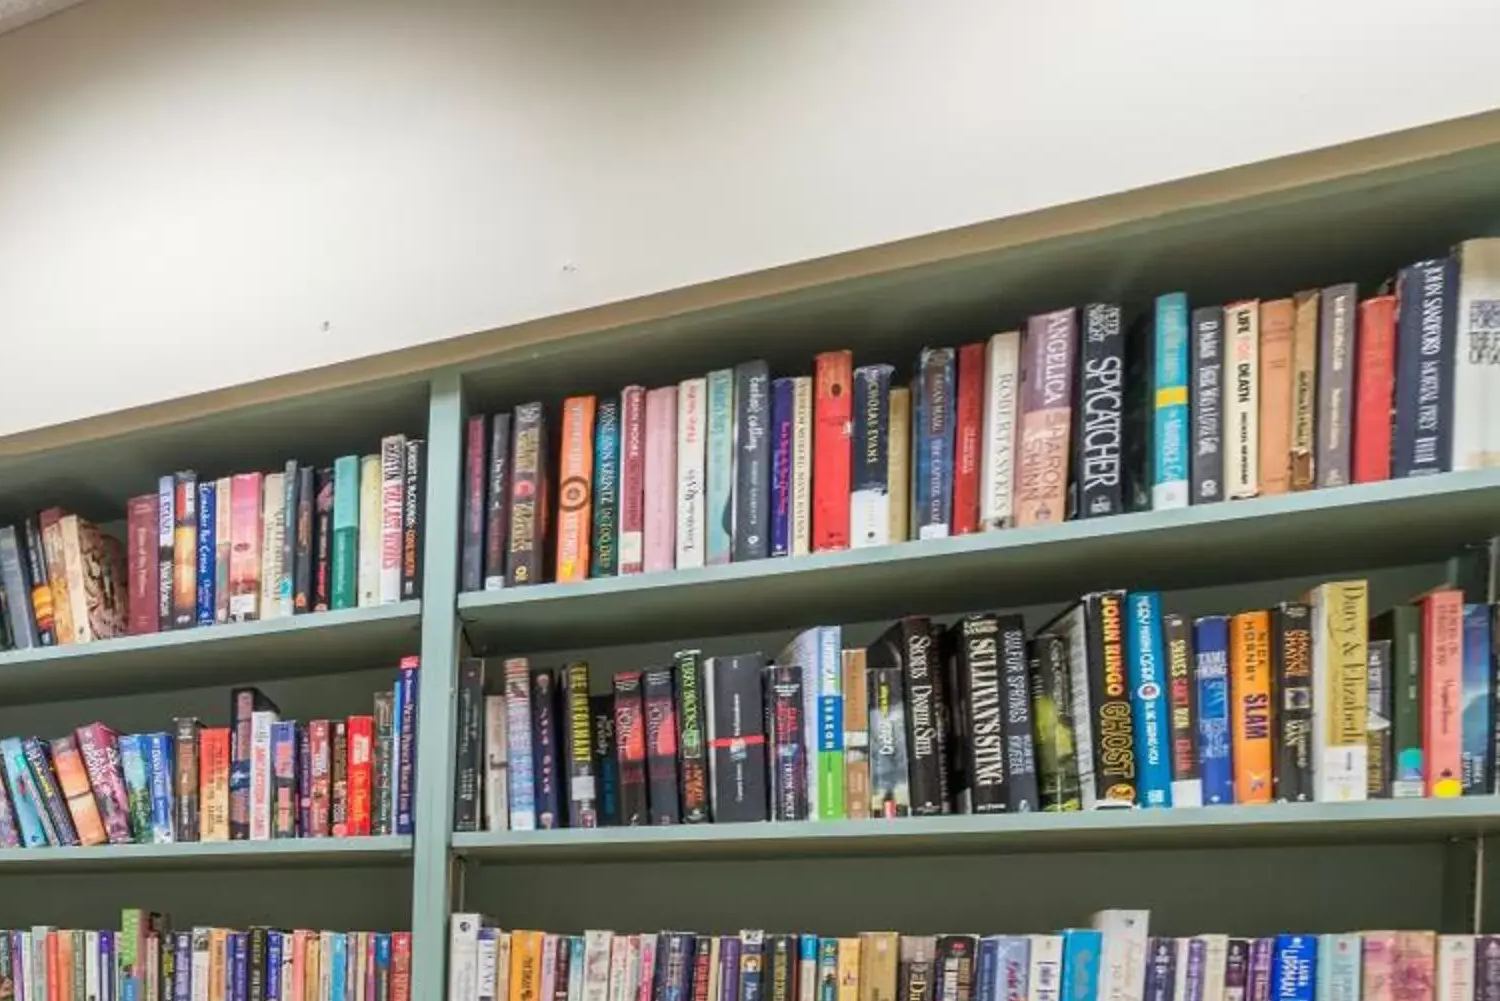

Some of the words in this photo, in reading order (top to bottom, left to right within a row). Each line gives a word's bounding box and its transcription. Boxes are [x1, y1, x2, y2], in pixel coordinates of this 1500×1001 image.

[1044, 313, 1070, 405] ANGELICA
[1238, 363, 1251, 403] DEATH
[1085, 356, 1121, 491] SPYCATCHER
[1022, 439, 1043, 502] SHINN
[1043, 413, 1068, 500] SHARON
[1102, 597, 1121, 642] JOHN
[1337, 585, 1363, 635] Darcy
[1004, 630, 1024, 673] SULFUR
[1104, 644, 1124, 696] RINGO
[1244, 621, 1258, 683] HORNBY
[1344, 641, 1361, 657] &
[571, 666, 588, 688] THE
[970, 638, 1000, 734] SULLIVAN'S
[1008, 675, 1028, 724] SPRINGS
[572, 692, 591, 762] INFORMANT
[1243, 693, 1268, 741] SLAM
[1340, 662, 1364, 744] Elizabeth
[975, 736, 1004, 786] STING
[1100, 701, 1135, 779] GHOST
[1281, 949, 1299, 997] LIPPMAN
[1298, 959, 1310, 986] LAURA
